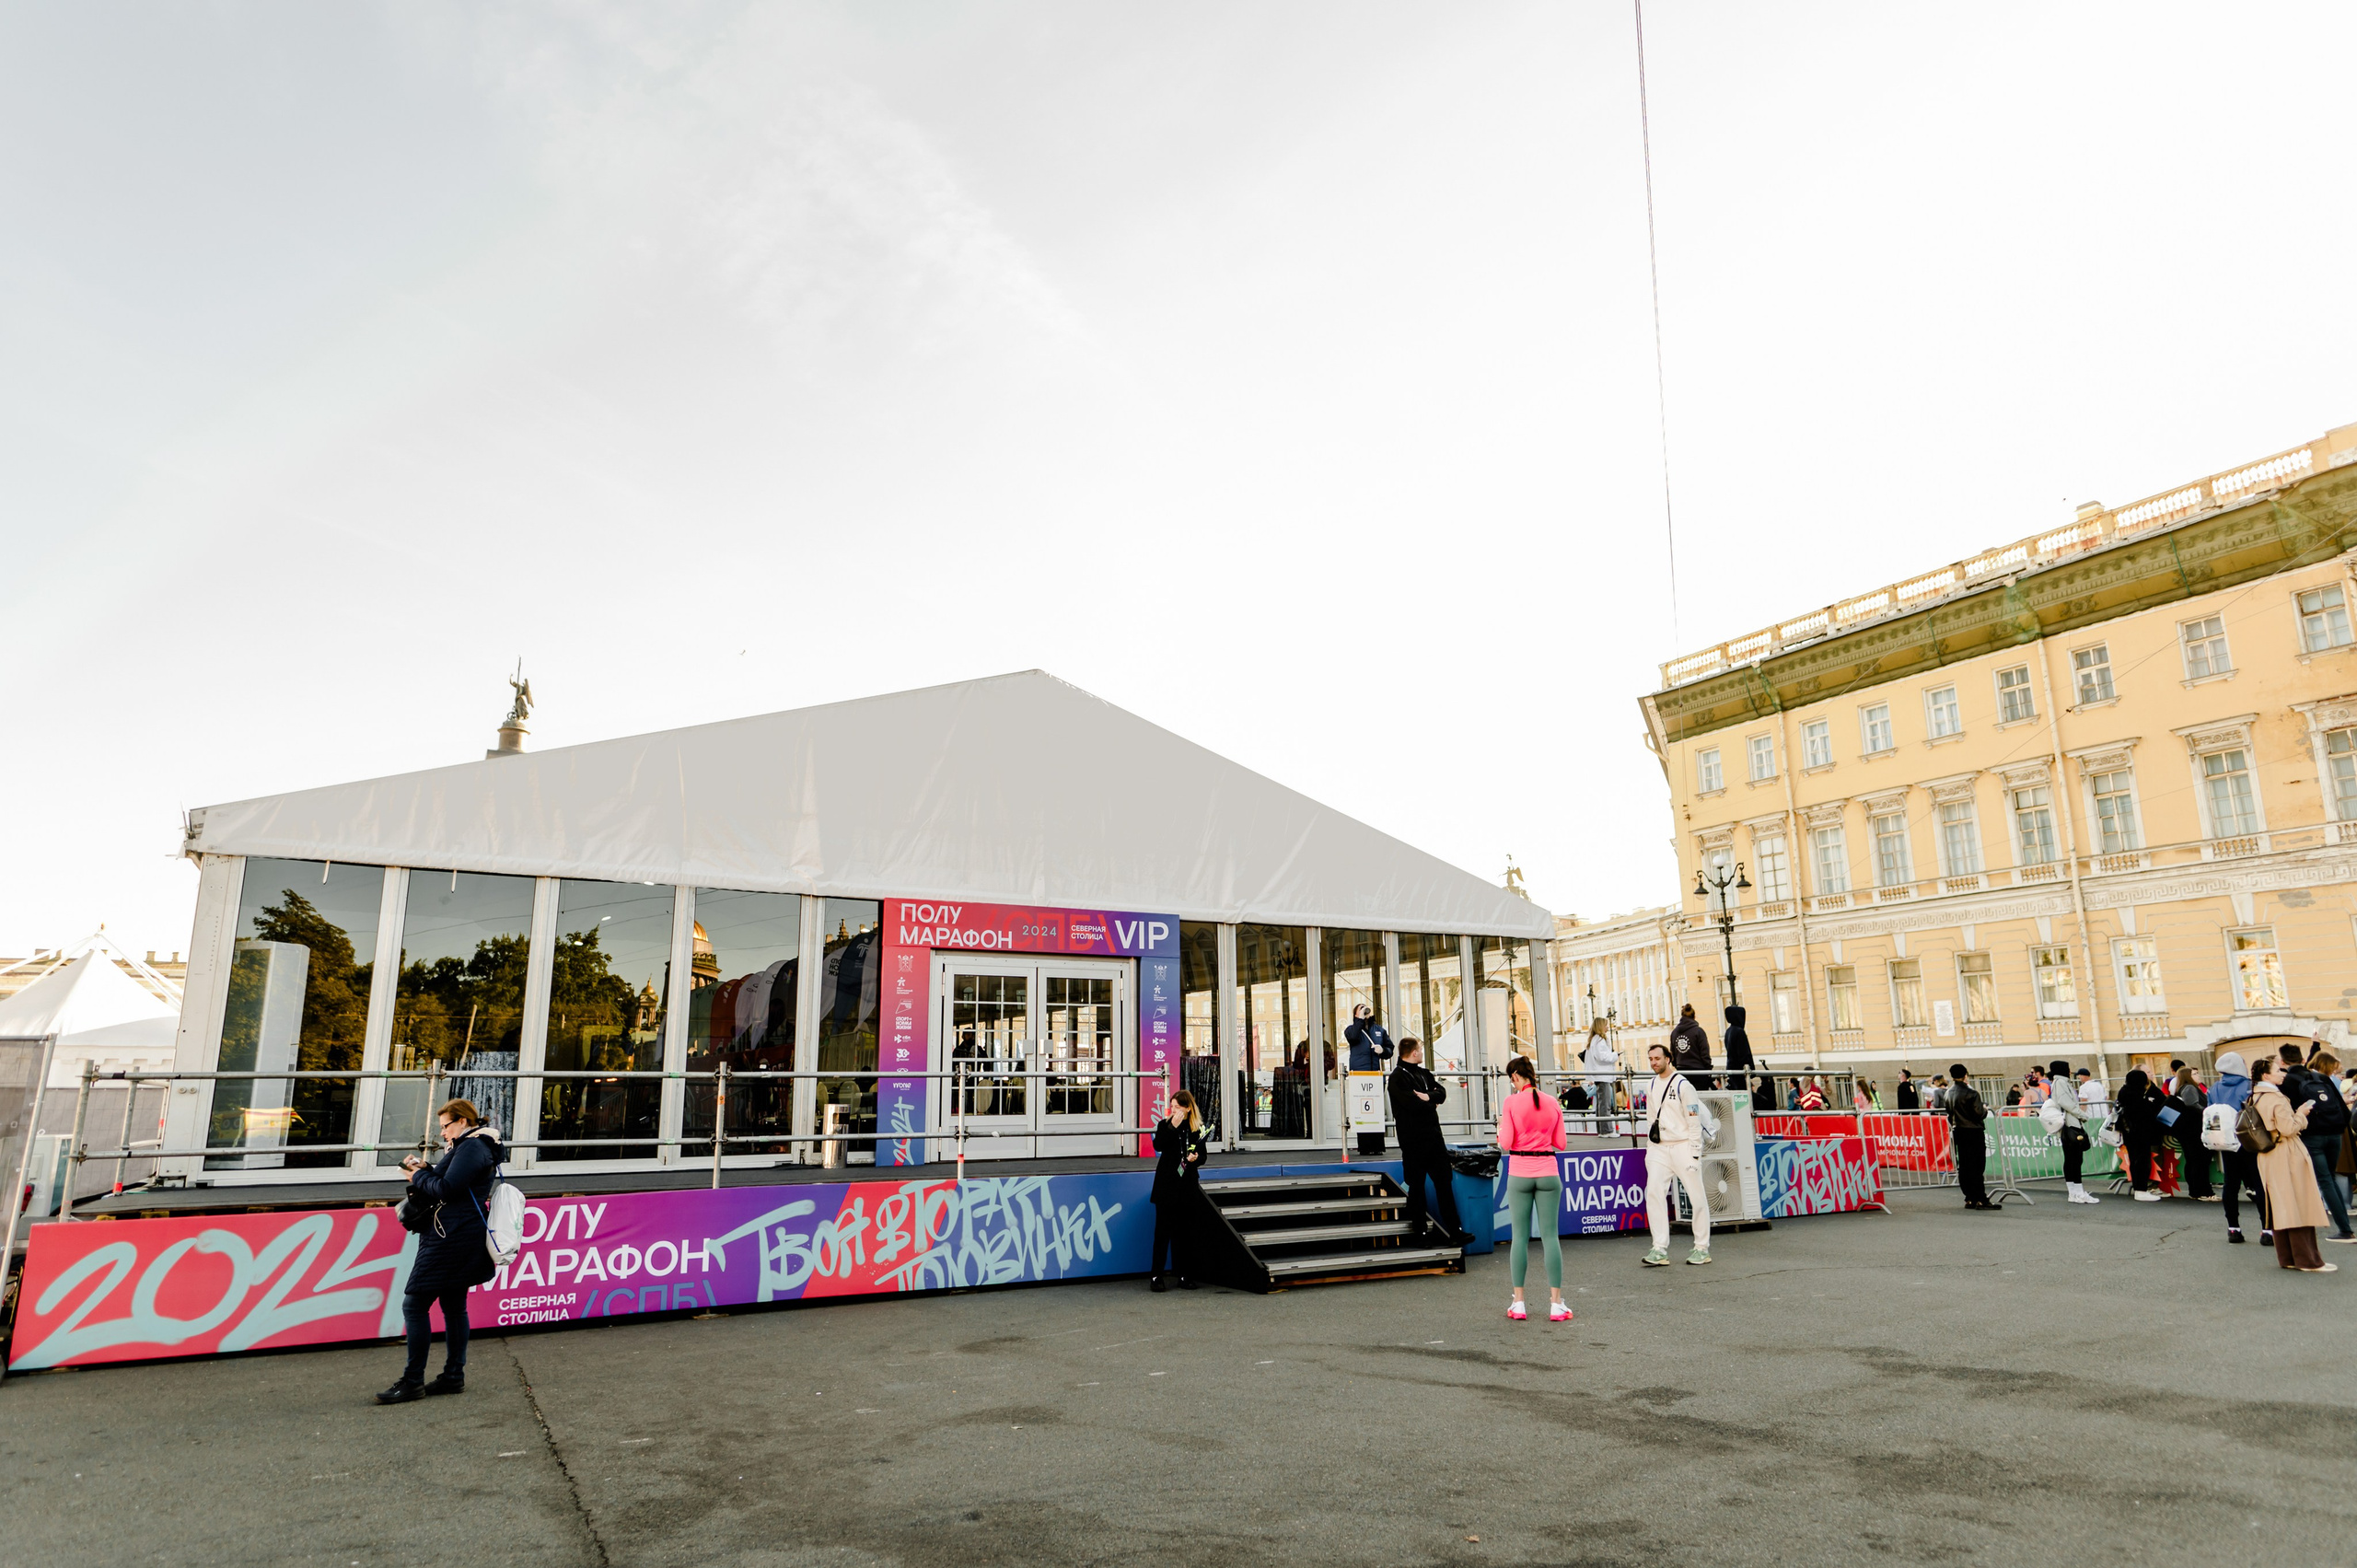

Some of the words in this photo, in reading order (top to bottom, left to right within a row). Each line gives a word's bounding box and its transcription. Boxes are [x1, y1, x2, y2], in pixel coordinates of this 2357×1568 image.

[900, 902, 962, 924] ПОЛУ
[1022, 924, 1057, 936] 2024
[1071, 924, 1107, 933] СЕВЕРНАЯ
[1114, 920, 1169, 950] VIP
[900, 925, 1013, 949] МАРАФОН
[1071, 933, 1104, 941] СТОЛИЦА
[1361, 1083, 1374, 1092] VIP
[1364, 1100, 1371, 1111] 6
[1873, 1134, 1926, 1148] ПИОНАТ
[2001, 1134, 2029, 1146] РИА
[2033, 1135, 2103, 1148] НОВИ
[2002, 1147, 2048, 1158] СПОРТ
[1563, 1156, 1623, 1182] ПОЛУ
[1565, 1183, 1675, 1213] МАРАФ
[522, 1202, 608, 1244] ОЛУ
[1581, 1214, 1617, 1225] СЕВЕРНАЯ
[1582, 1225, 1615, 1234] СТОЛИЦА
[9, 1213, 420, 1371] 2024
[498, 1293, 576, 1311] СЕВЕРНАЯ
[497, 1308, 570, 1326] СТОЛИЦА
